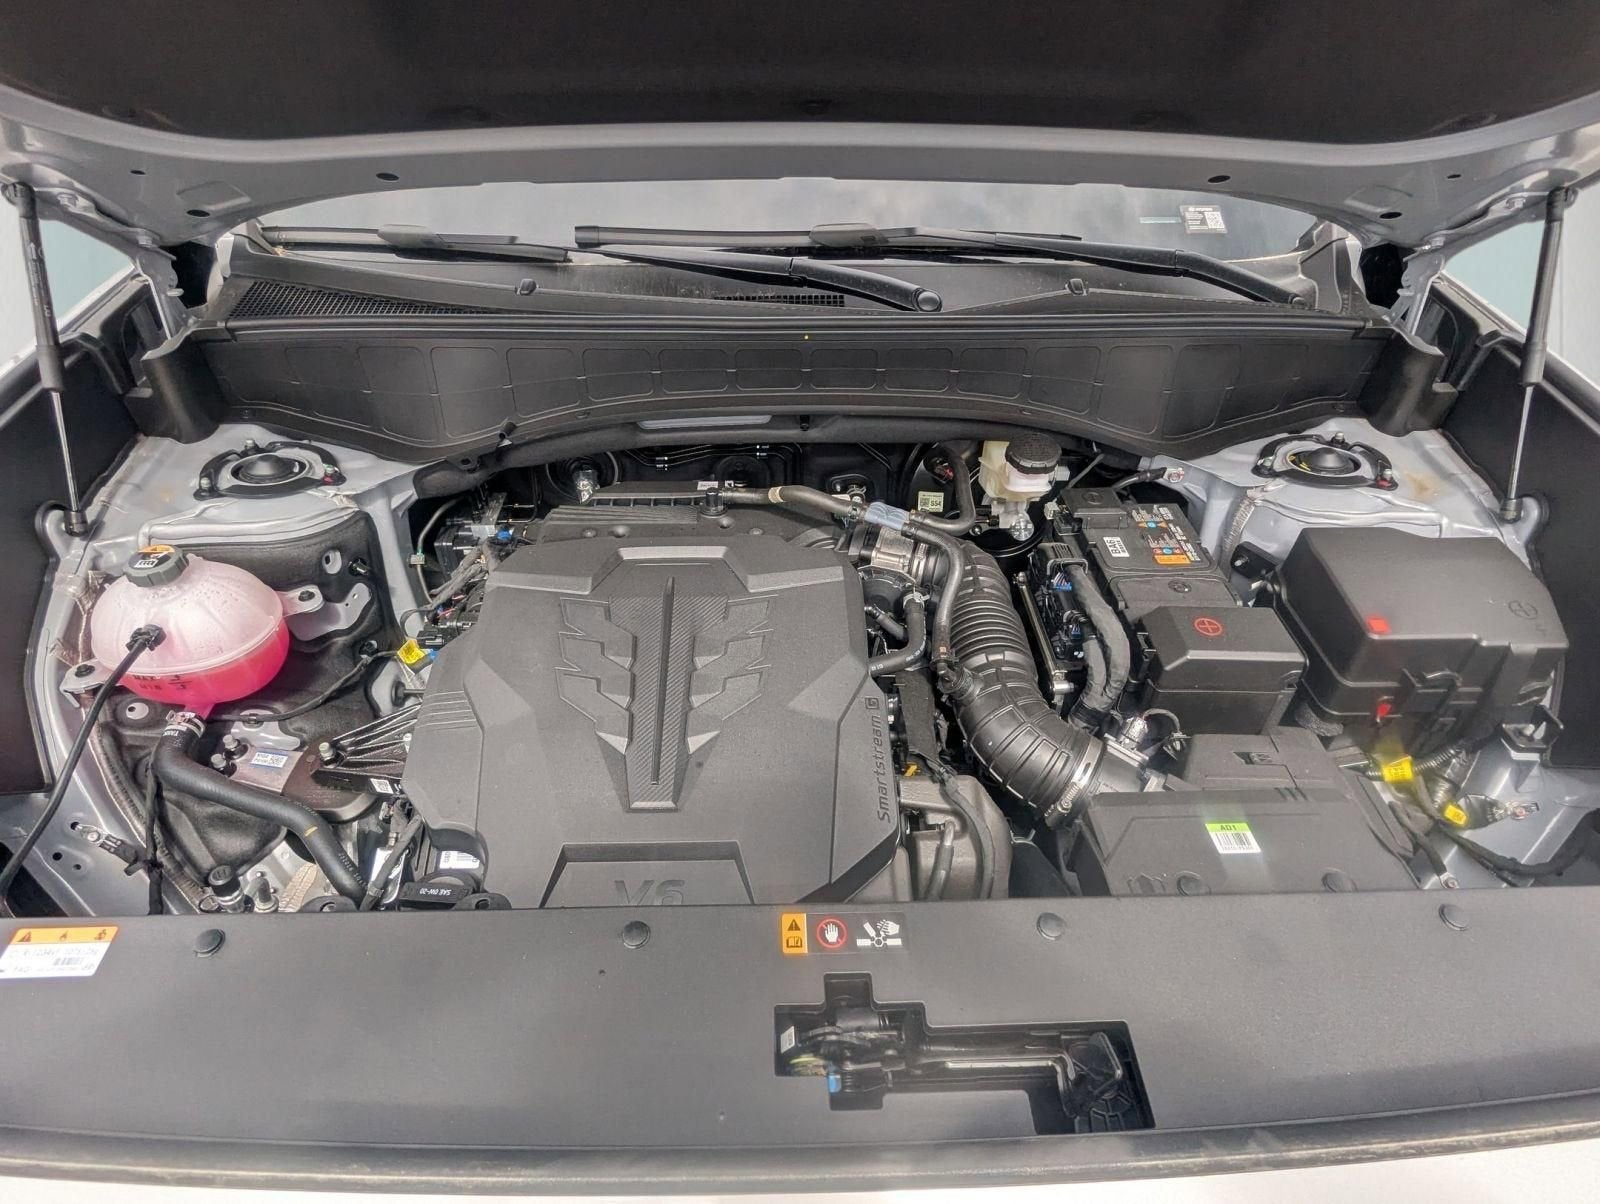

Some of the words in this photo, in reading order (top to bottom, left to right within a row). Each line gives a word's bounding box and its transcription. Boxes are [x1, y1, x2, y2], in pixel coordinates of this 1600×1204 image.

[871, 715, 891, 823] Smartstream
[440, 888, 452, 896] SAE
[614, 879, 686, 905] V6
